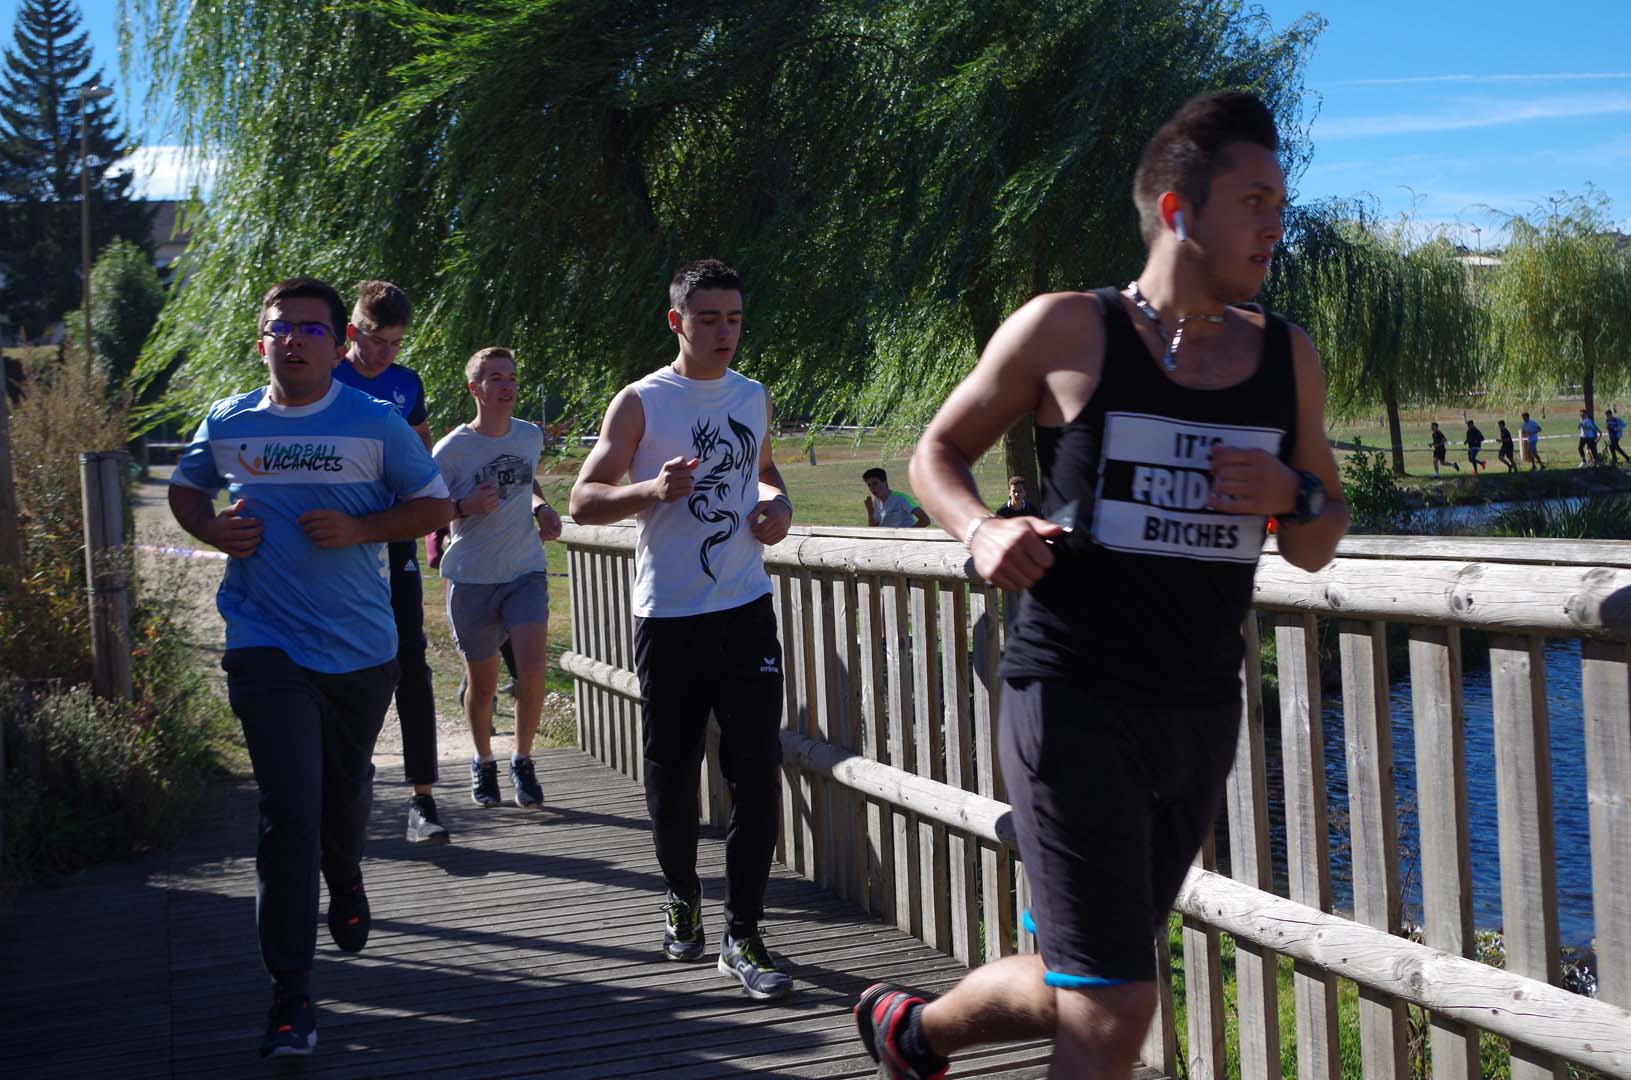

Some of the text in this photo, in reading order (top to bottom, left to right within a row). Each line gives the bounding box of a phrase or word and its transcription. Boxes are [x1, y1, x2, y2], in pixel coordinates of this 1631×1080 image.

[263, 455, 343, 472] VACANCES
[264, 442, 336, 460] HANDBALL
[1132, 465, 1216, 510] FRID
[1143, 515, 1238, 549] BITCHES
